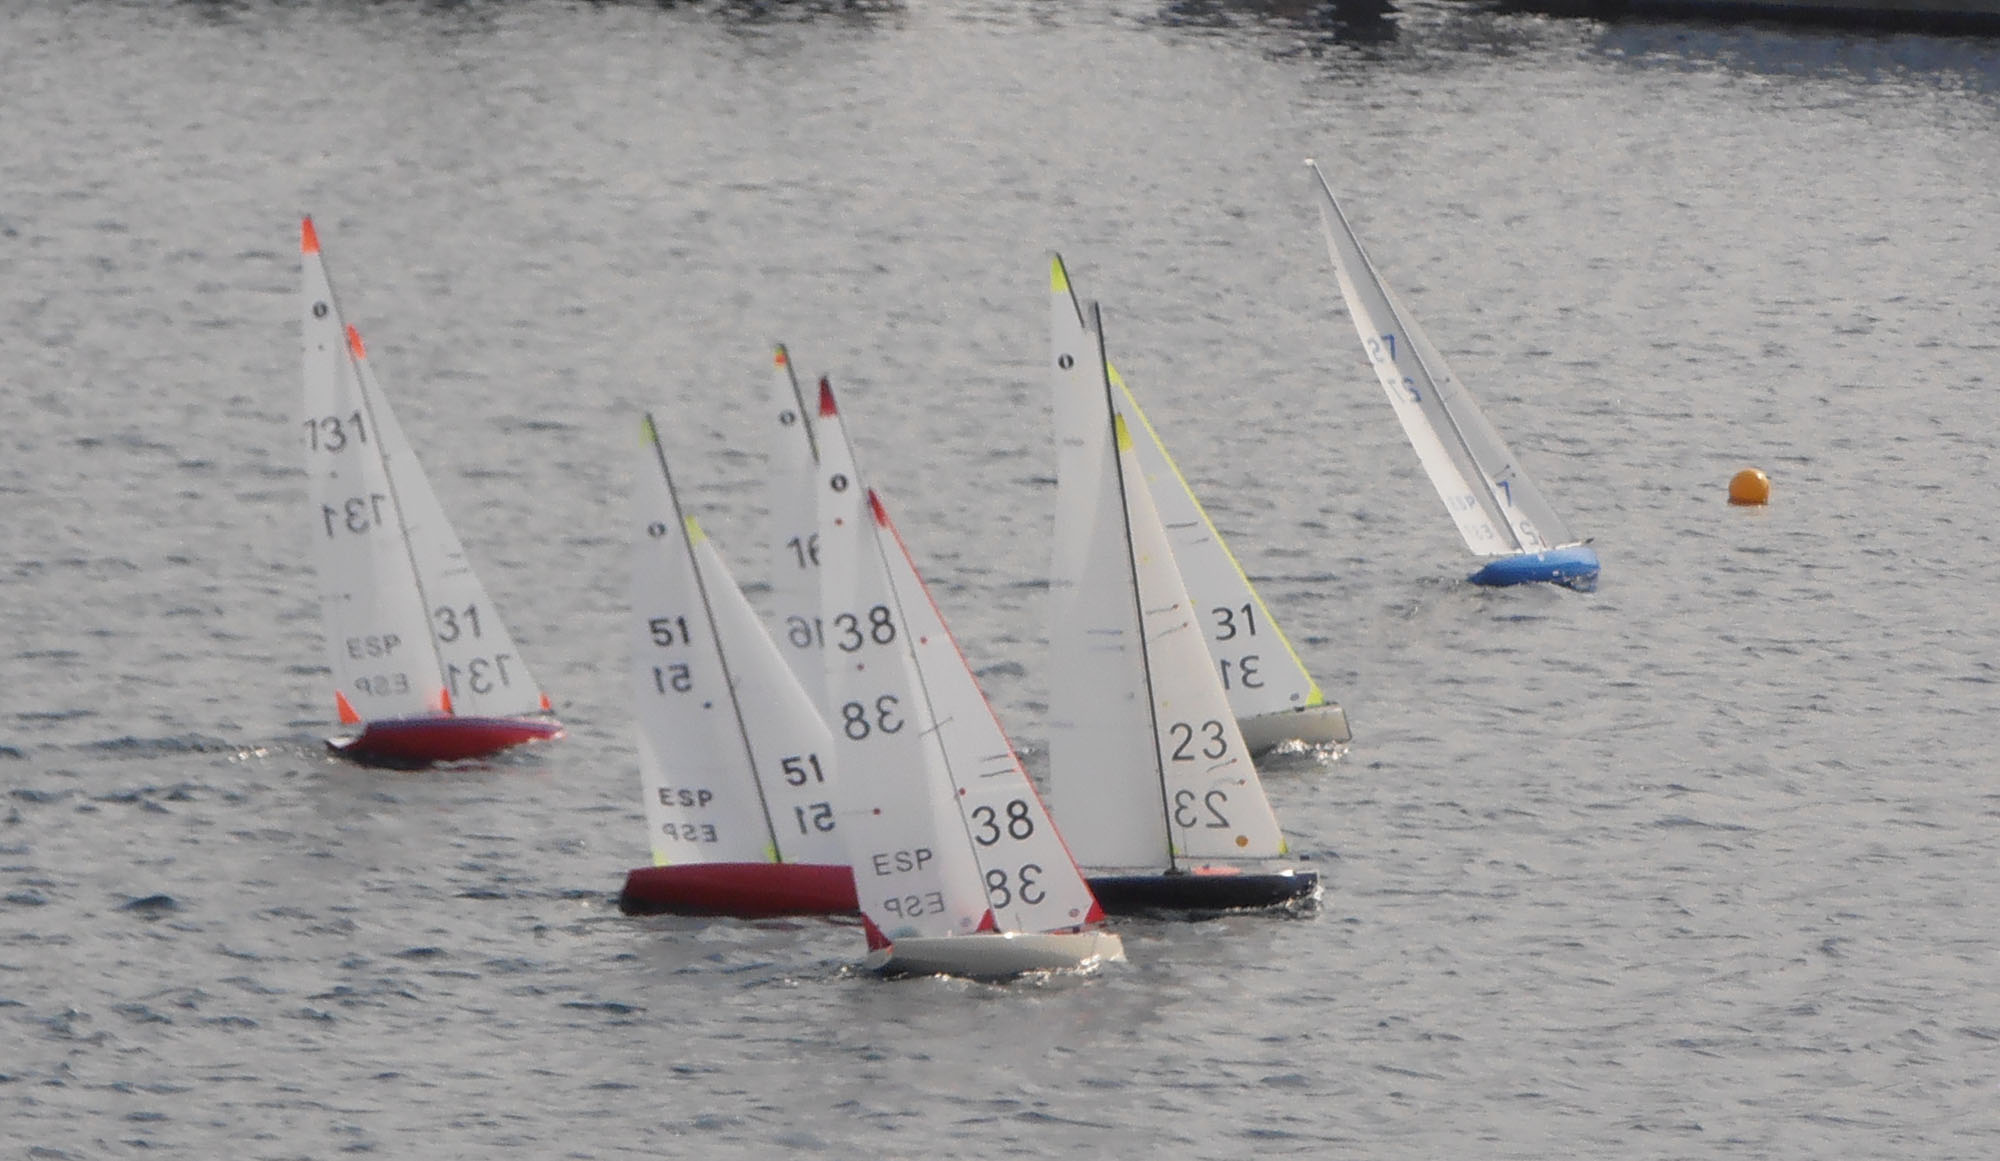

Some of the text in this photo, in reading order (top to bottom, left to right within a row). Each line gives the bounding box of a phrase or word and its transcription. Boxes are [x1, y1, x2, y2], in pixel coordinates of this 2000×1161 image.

[305, 410, 367, 451] 131
[650, 616, 690, 647] 51
[834, 606, 896, 652] 38
[1211, 603, 1256, 641] 31
[347, 633, 402, 660] ESP
[1169, 720, 1228, 762] 23
[781, 754, 825, 786] 51
[658, 787, 713, 808] ESP
[971, 799, 1034, 847] 38
[872, 848, 933, 877] ESP
